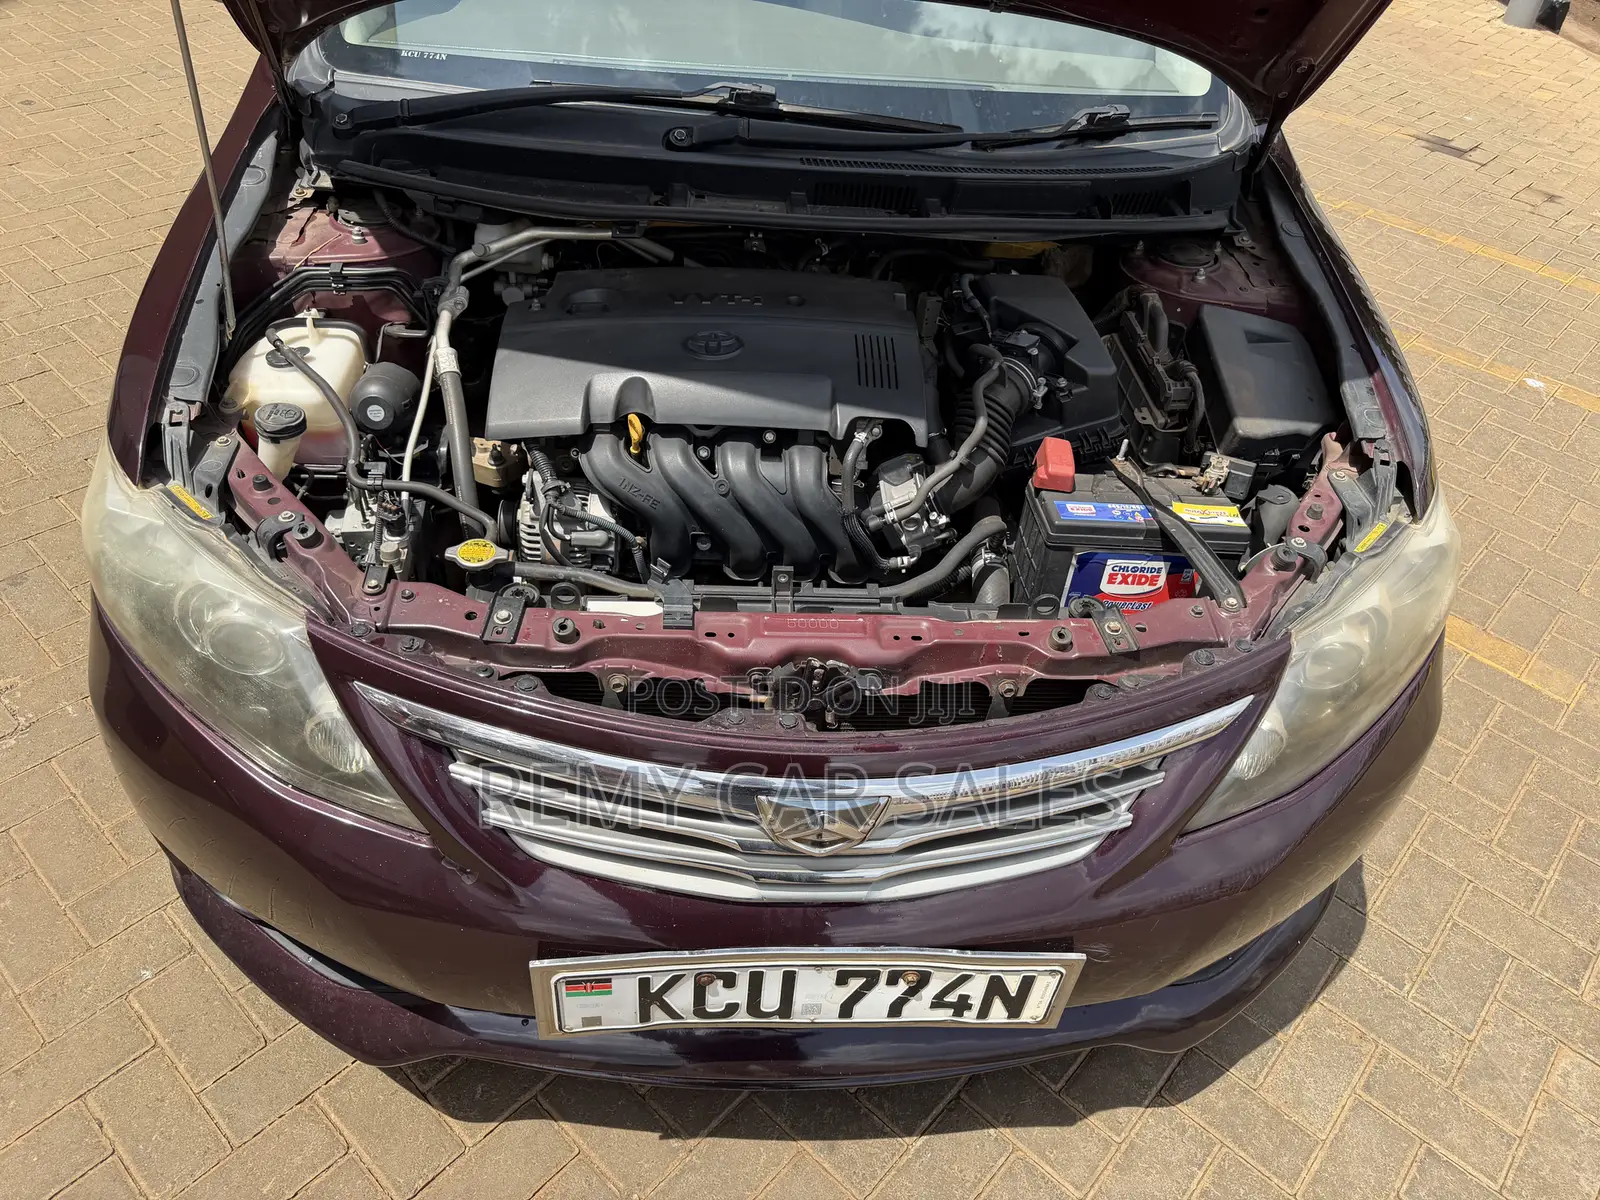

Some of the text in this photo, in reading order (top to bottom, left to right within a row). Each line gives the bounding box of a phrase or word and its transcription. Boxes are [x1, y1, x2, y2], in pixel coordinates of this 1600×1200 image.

[401, 50, 448, 60] KCU 774N
[1111, 565, 1163, 574] CHLORIDE
[1106, 573, 1161, 586] EXIDE
[637, 968, 798, 1024] KCU
[834, 968, 1038, 1020] 774N
